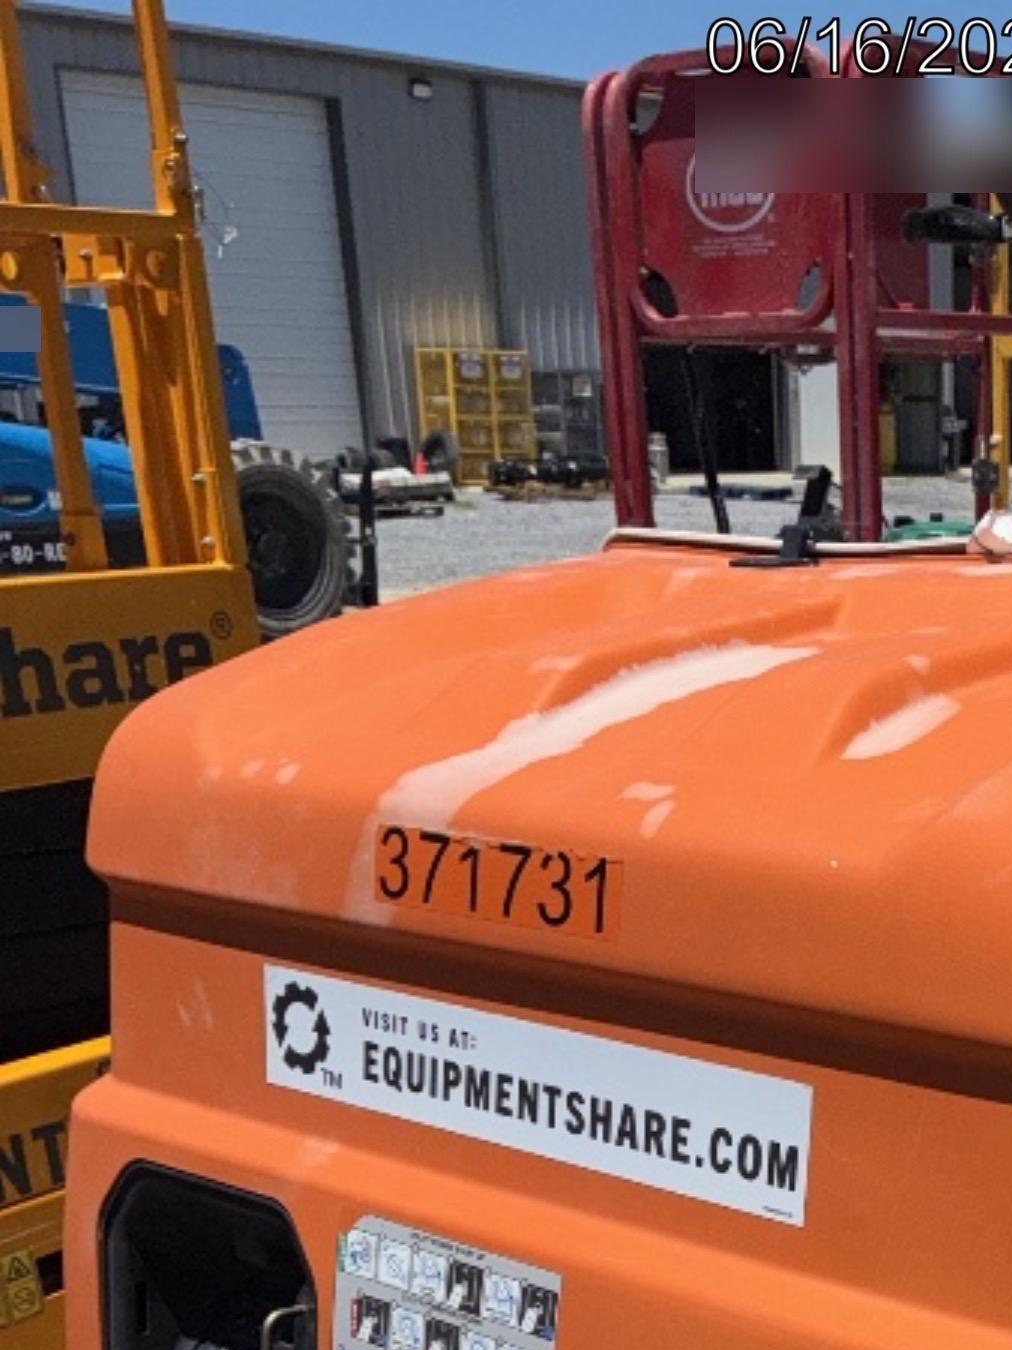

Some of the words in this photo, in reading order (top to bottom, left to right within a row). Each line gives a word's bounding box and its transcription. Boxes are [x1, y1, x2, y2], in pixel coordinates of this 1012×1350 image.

[379, 826, 608, 934] 371731
[362, 1007, 408, 1036] VISIT
[418, 1020, 439, 1042] US
[449, 1028, 477, 1049] AT:
[320, 1066, 342, 1089] TM
[363, 1040, 799, 1192] EQUIPMENTSHARE.COM
